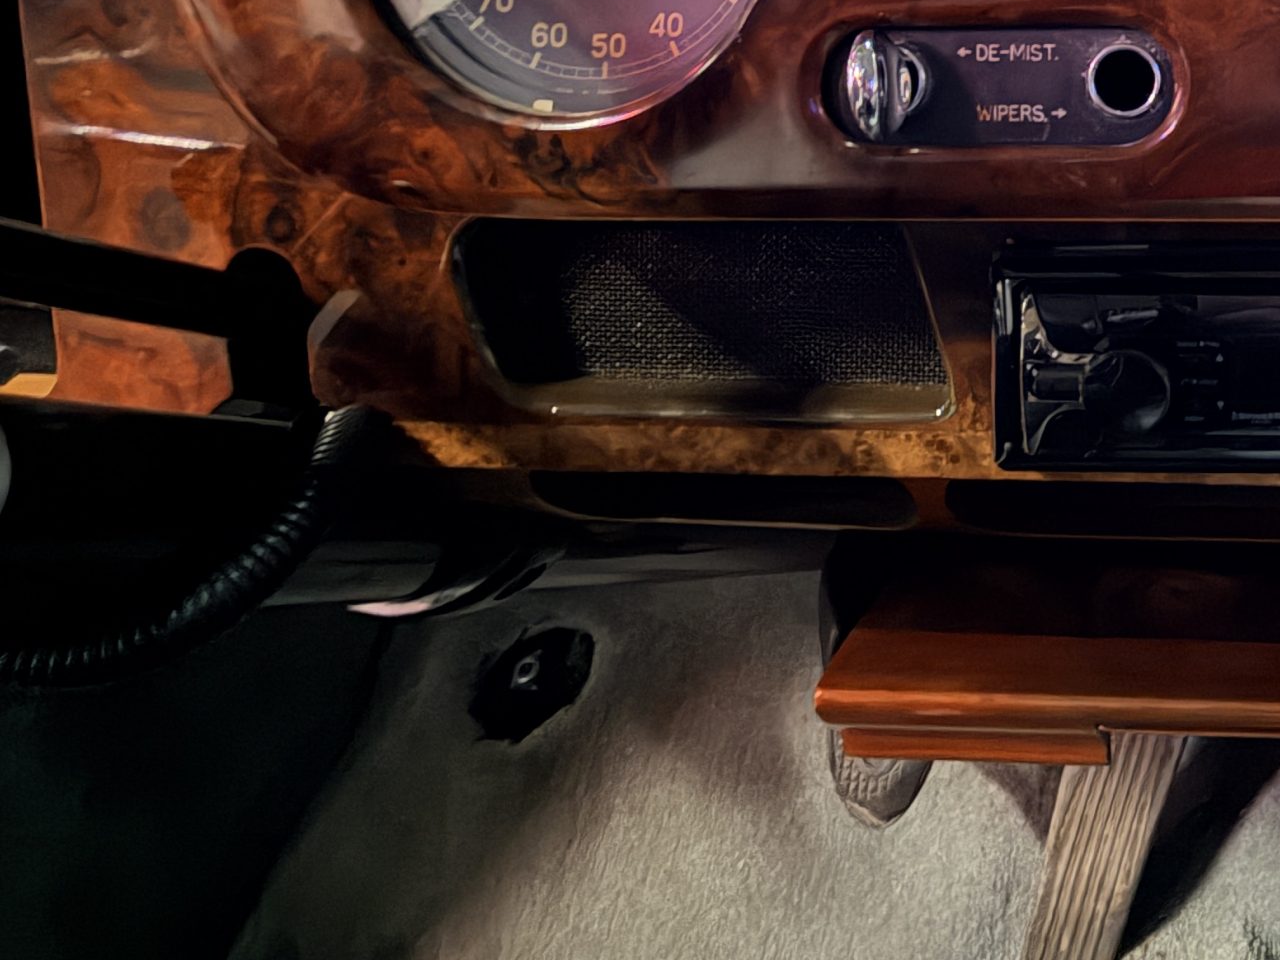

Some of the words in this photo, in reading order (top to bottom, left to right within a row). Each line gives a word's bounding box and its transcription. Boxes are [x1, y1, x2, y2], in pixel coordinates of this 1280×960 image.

[531, 23, 568, 49] 60
[649, 12, 684, 38] 40
[591, 33, 627, 59] 50
[975, 43, 1060, 62] DE-MIST.
[976, 103, 1049, 123] WIPERS.
